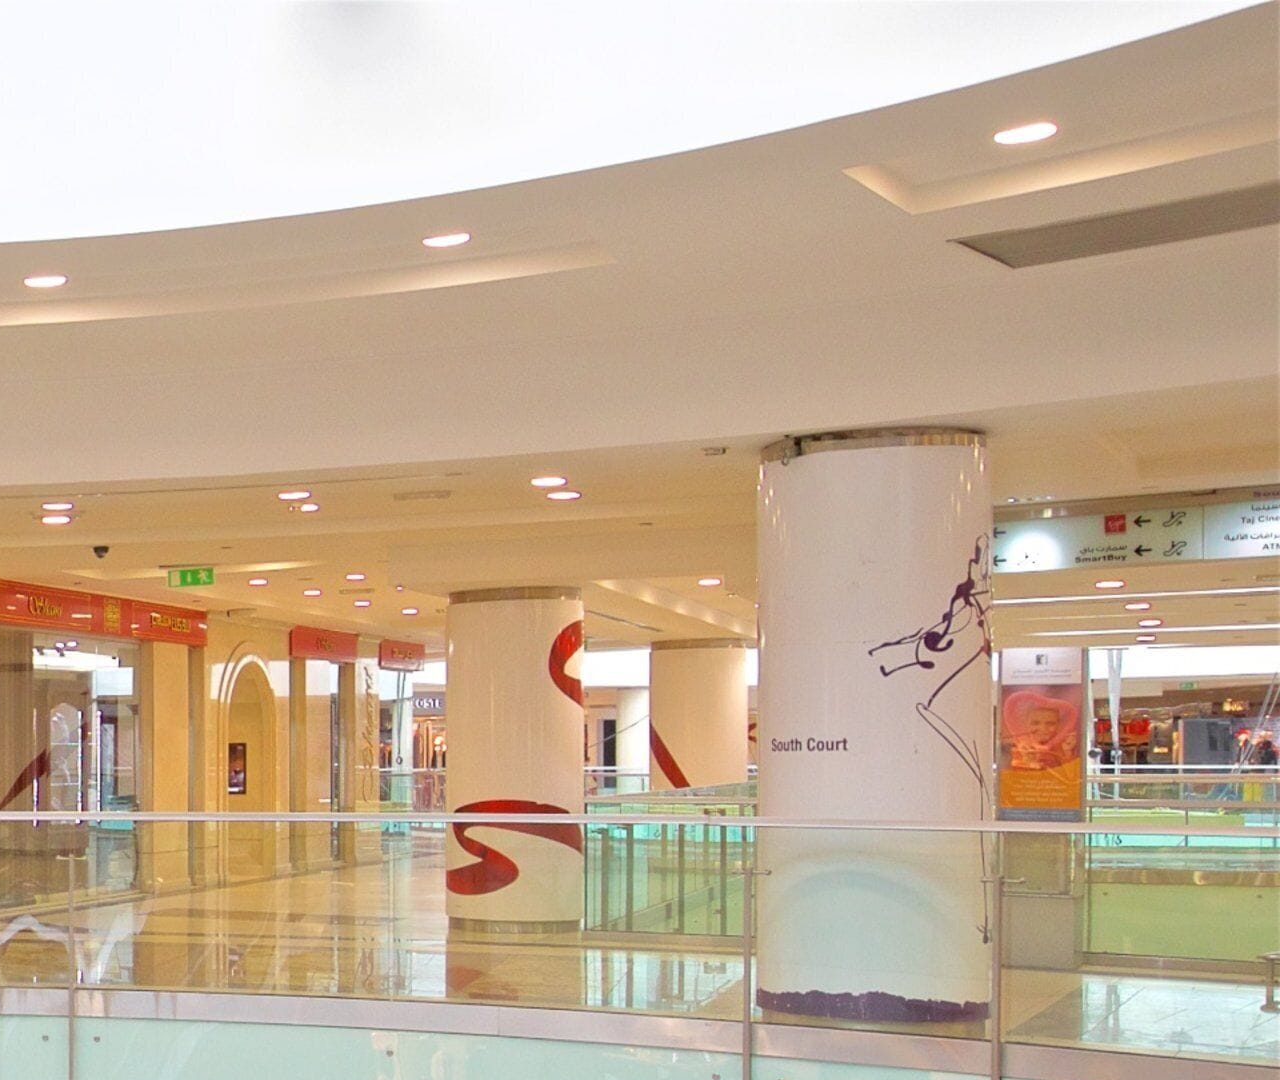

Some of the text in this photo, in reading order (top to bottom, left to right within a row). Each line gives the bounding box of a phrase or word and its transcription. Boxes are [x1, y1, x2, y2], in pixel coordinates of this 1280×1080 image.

[1075, 554, 1127, 564] SmartBuy
[771, 737, 849, 752] South Court
